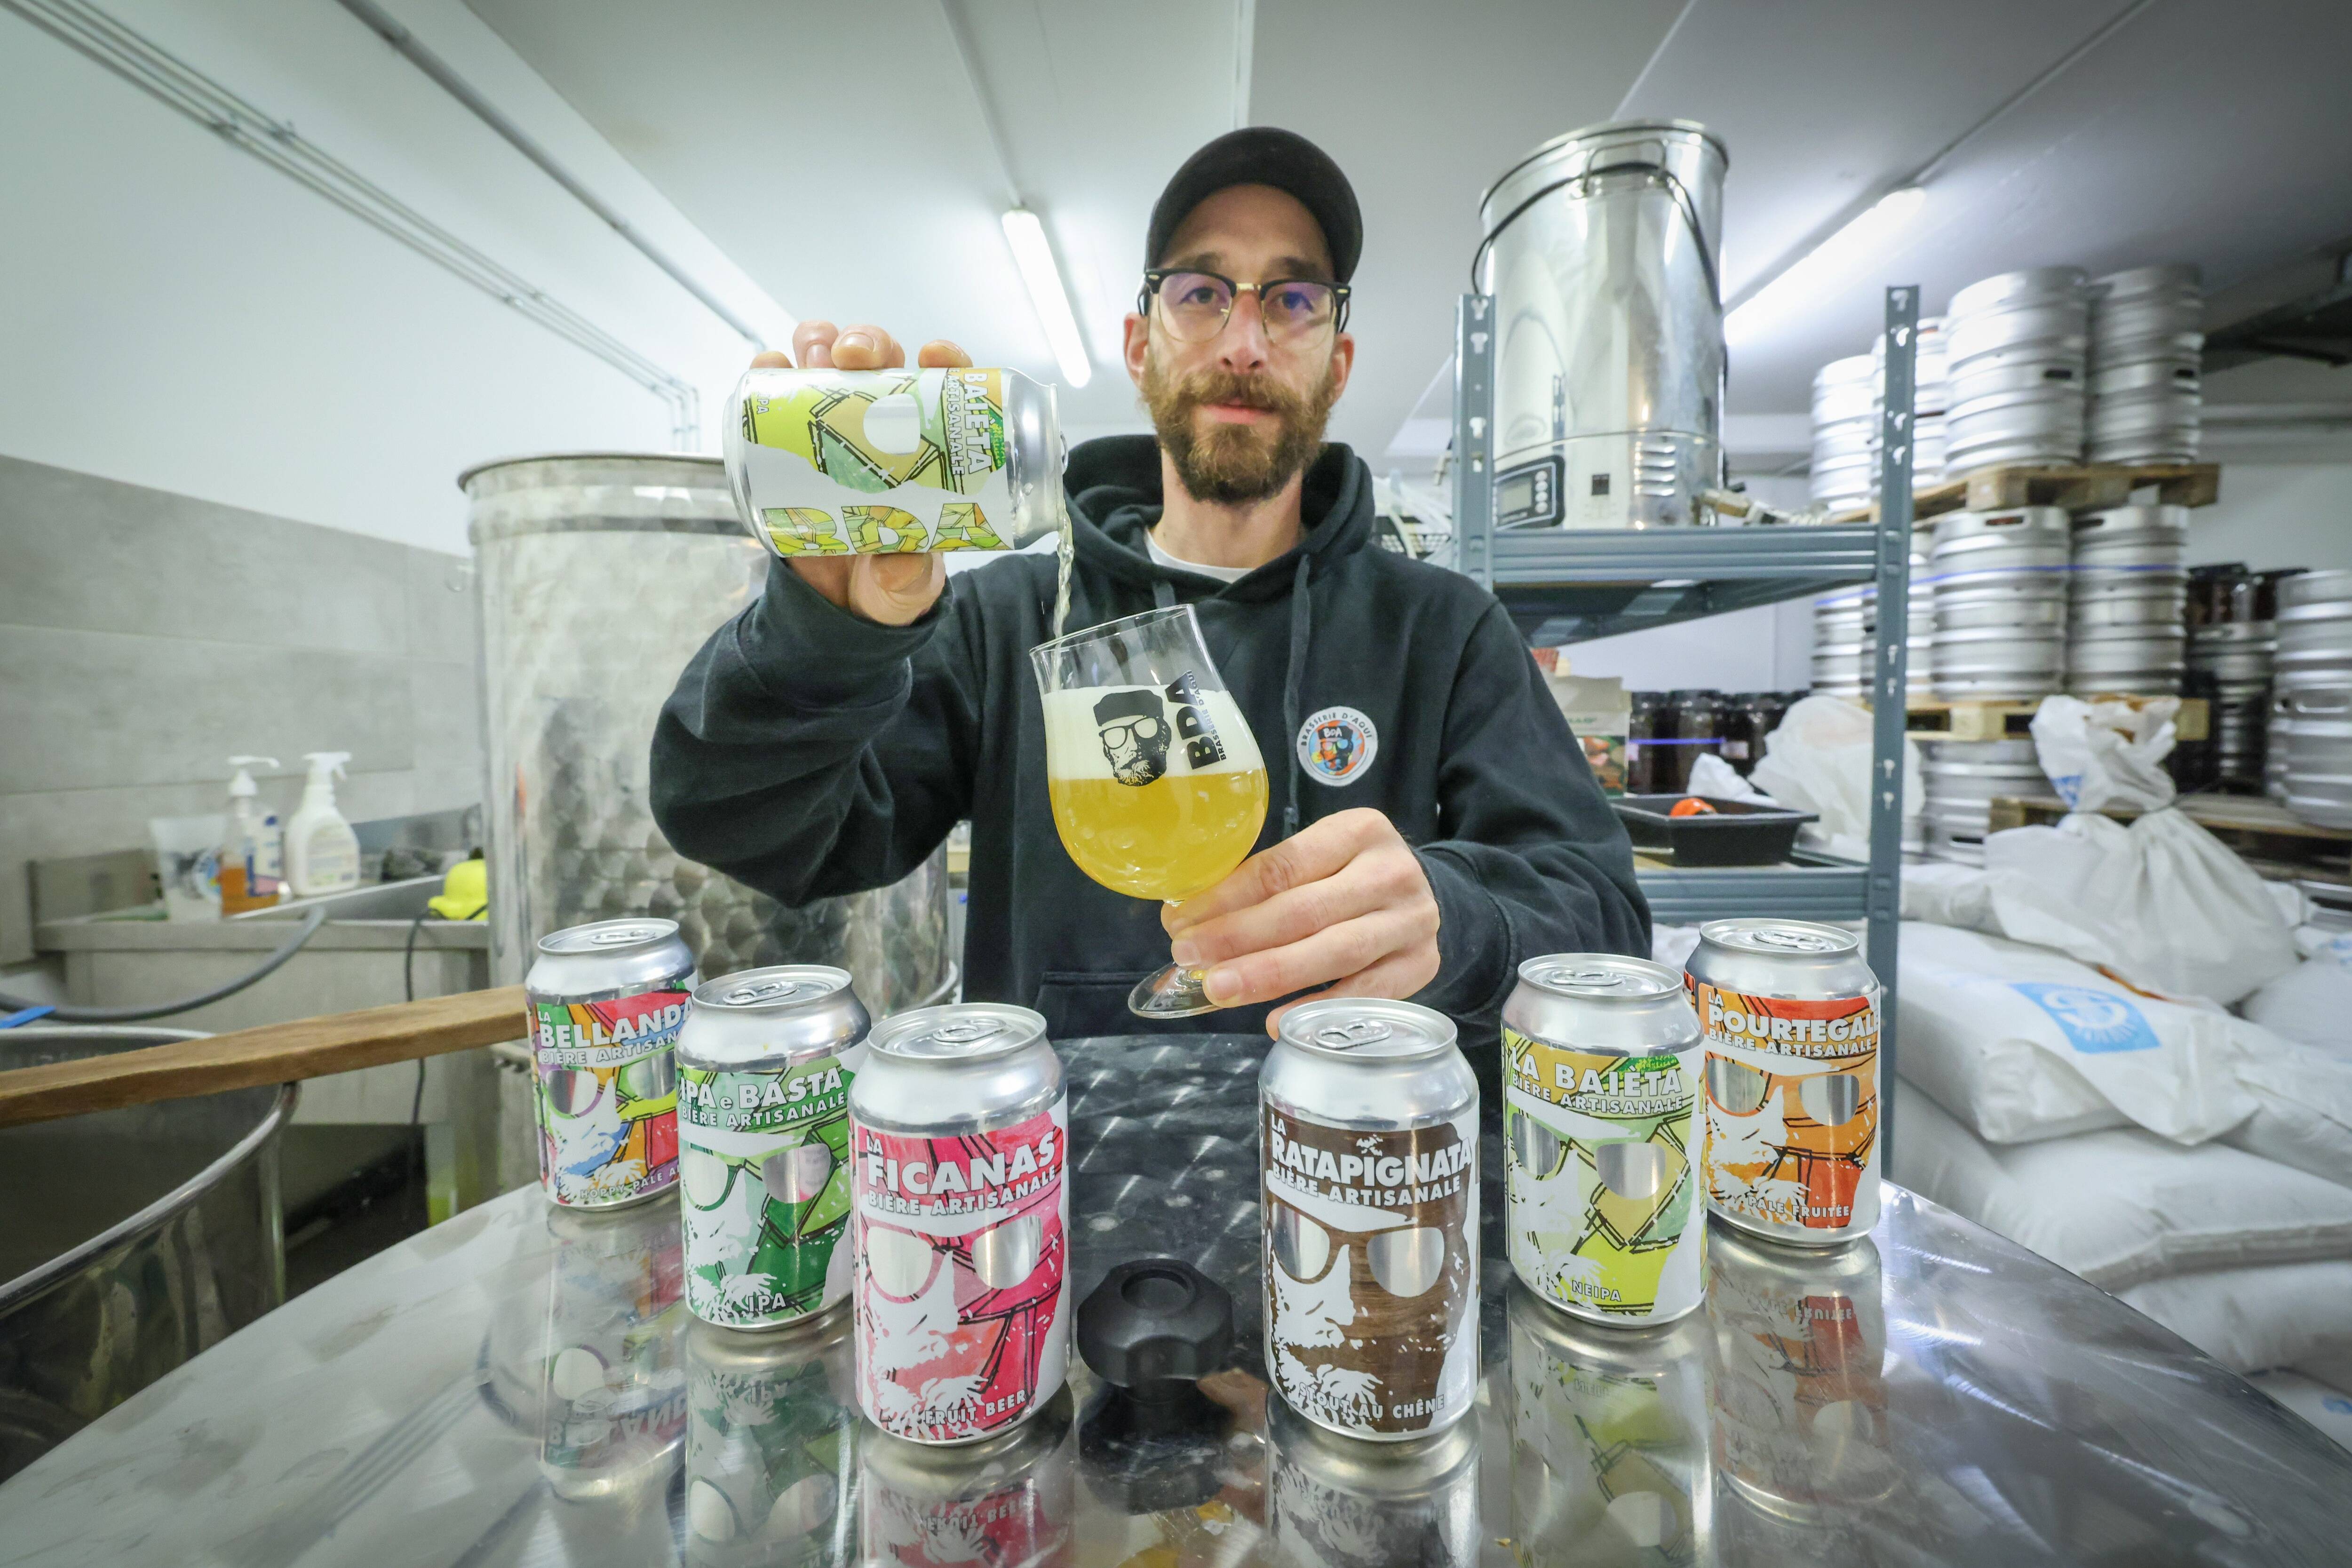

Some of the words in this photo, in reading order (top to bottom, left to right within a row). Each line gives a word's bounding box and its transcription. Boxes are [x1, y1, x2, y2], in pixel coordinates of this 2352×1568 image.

[946, 374, 964, 476] ARTISANALE
[963, 373, 995, 474] BAIÈTA
[762, 503, 1014, 558] BDA
[1186, 670, 1205, 706] D'AQUI
[1165, 673, 1220, 769] BDA
[1202, 709, 1226, 760] BRASSERIE
[1301, 712, 1336, 746] BRASSERIE
[1342, 713, 1372, 738] D'AQUI
[538, 1011, 551, 1023] LA
[1708, 991, 1725, 1007] LA
[540, 1050, 587, 1065] BIÈRE
[596, 1031, 676, 1062] ARTISAN
[1708, 1027, 1756, 1051] BIÈRE
[1764, 1038, 1872, 1058] ARTISANALE
[680, 1077, 717, 1109] IPA
[719, 1097, 733, 1109] e
[738, 1067, 843, 1109] BASTA
[1511, 1046, 1540, 1081] LA
[1554, 1062, 1683, 1097] BAIÈTA
[682, 1106, 717, 1126] BIÈRE
[726, 1091, 845, 1127] ARTISANALE
[1512, 1073, 1551, 1102] BIÈRE
[1560, 1093, 1683, 1114] ARTISANALE
[1271, 1113, 1287, 1137] LA
[866, 1134, 883, 1155] LA
[867, 1131, 1056, 1195] FICANAS
[1271, 1130, 1473, 1187] RATAPIGNATA
[580, 1185, 625, 1199] HOPPY
[633, 1172, 663, 1191] PALE
[868, 1190, 921, 1216] BIÈRE
[930, 1164, 1057, 1216] ARTISANALE
[1272, 1161, 1319, 1197] BIÈRE
[1328, 1175, 1460, 1206] ARTISANALE
[1748, 1195, 1786, 1214] PALE
[1792, 1204, 1850, 1218] FRUITÉE
[748, 1292, 787, 1313] IPA
[1572, 1280, 1622, 1302] NEIPA
[924, 1407, 977, 1426] FRUIT
[985, 1389, 1028, 1417] BEER
[1299, 1382, 1350, 1414] STOUT
[1357, 1402, 1383, 1419] AU
[1392, 1394, 1445, 1419] CHÊNE
